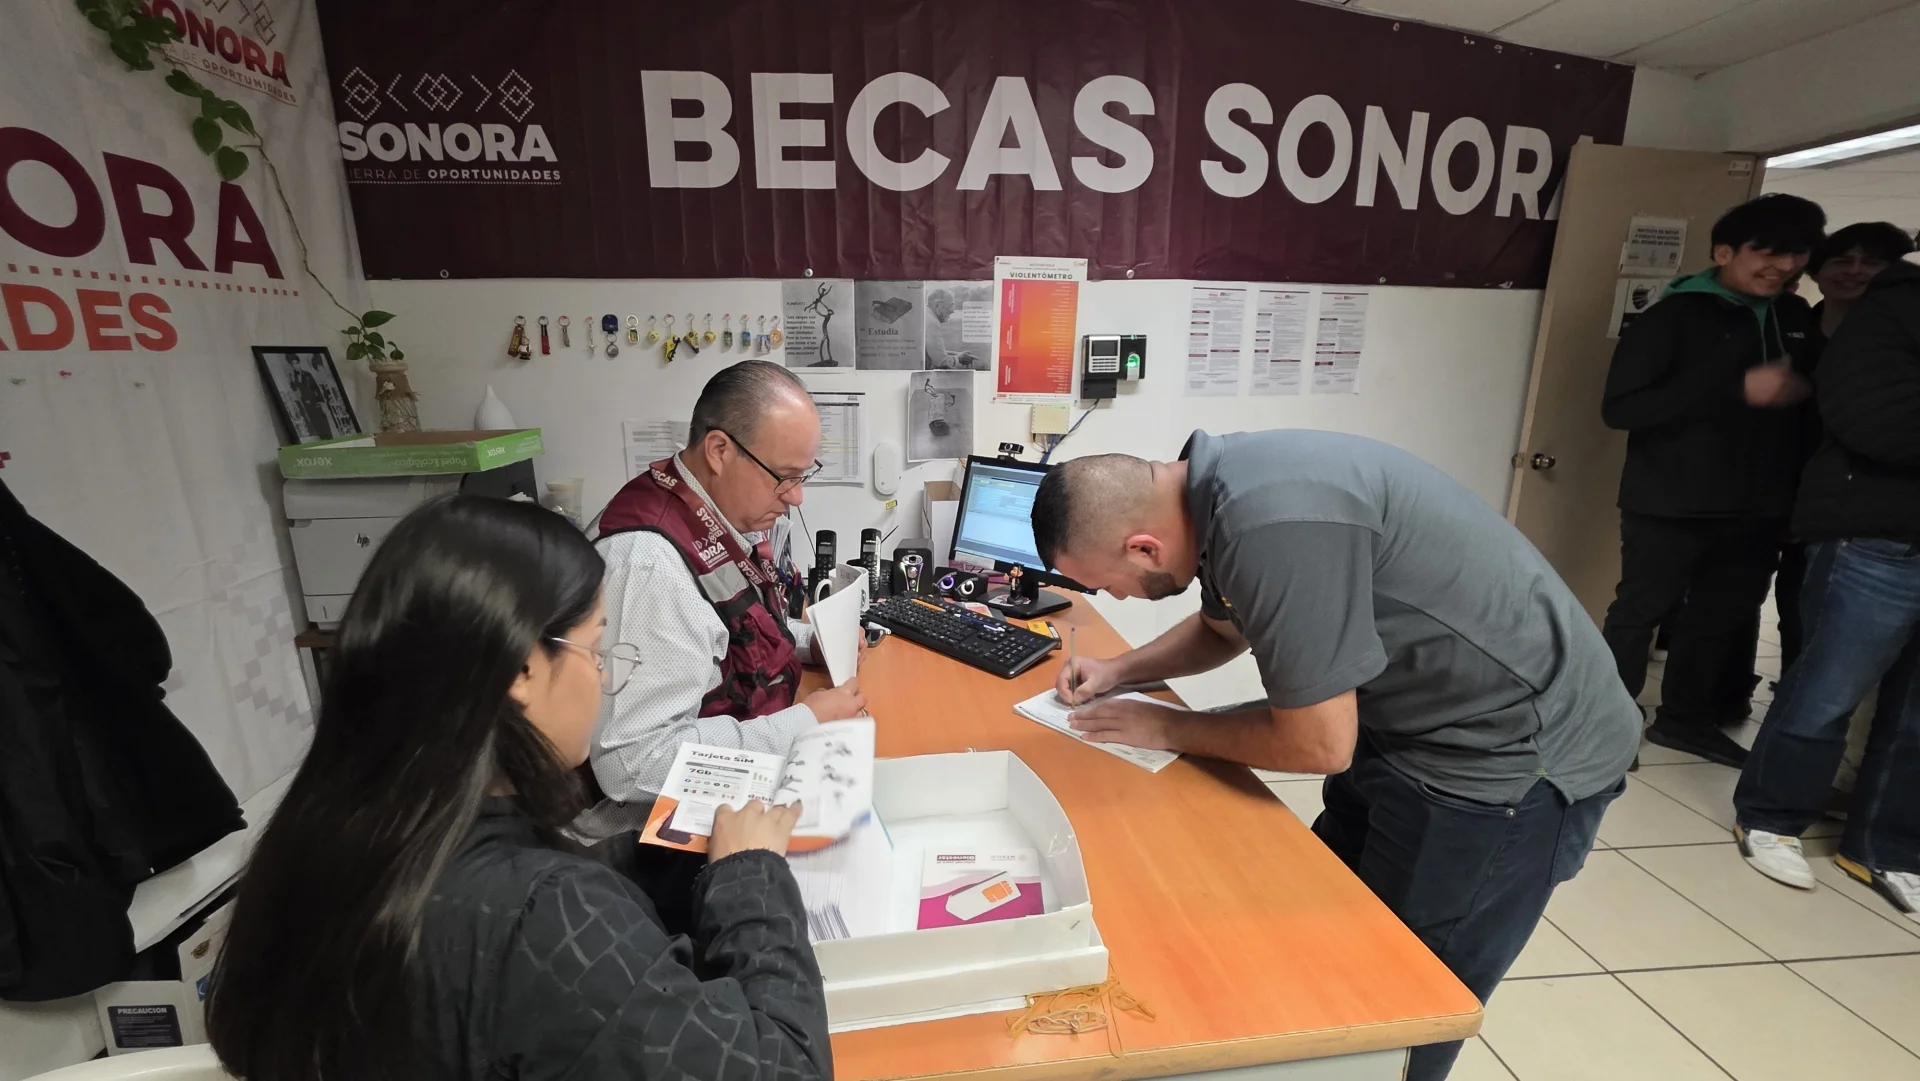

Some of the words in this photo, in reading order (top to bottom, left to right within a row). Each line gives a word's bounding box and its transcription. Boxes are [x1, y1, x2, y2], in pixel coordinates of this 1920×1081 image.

[138, 0, 293, 89] ONORA
[203, 58, 297, 103] OPORTUNIDADES
[640, 71, 1156, 193] BECAS
[338, 121, 558, 162] SONORA
[349, 168, 397, 180] IERRA
[404, 169, 421, 180] DE
[427, 168, 561, 181] OPORTUNIDADES
[1010, 271, 1073, 280] VIOLENTÓMETRO
[0, 283, 178, 351] DES
[868, 327, 899, 336] Estudia
[486, 446, 506, 457] xerox
[297, 456, 333, 467] xerox
[441, 456, 467, 467] Papel
[696, 507, 724, 538] BECAS
[356, 532, 370, 548] hp
[737, 560, 763, 585] BECAS
[691, 750, 731, 761] Tarjeta
[688, 767, 712, 776] 7Gb
